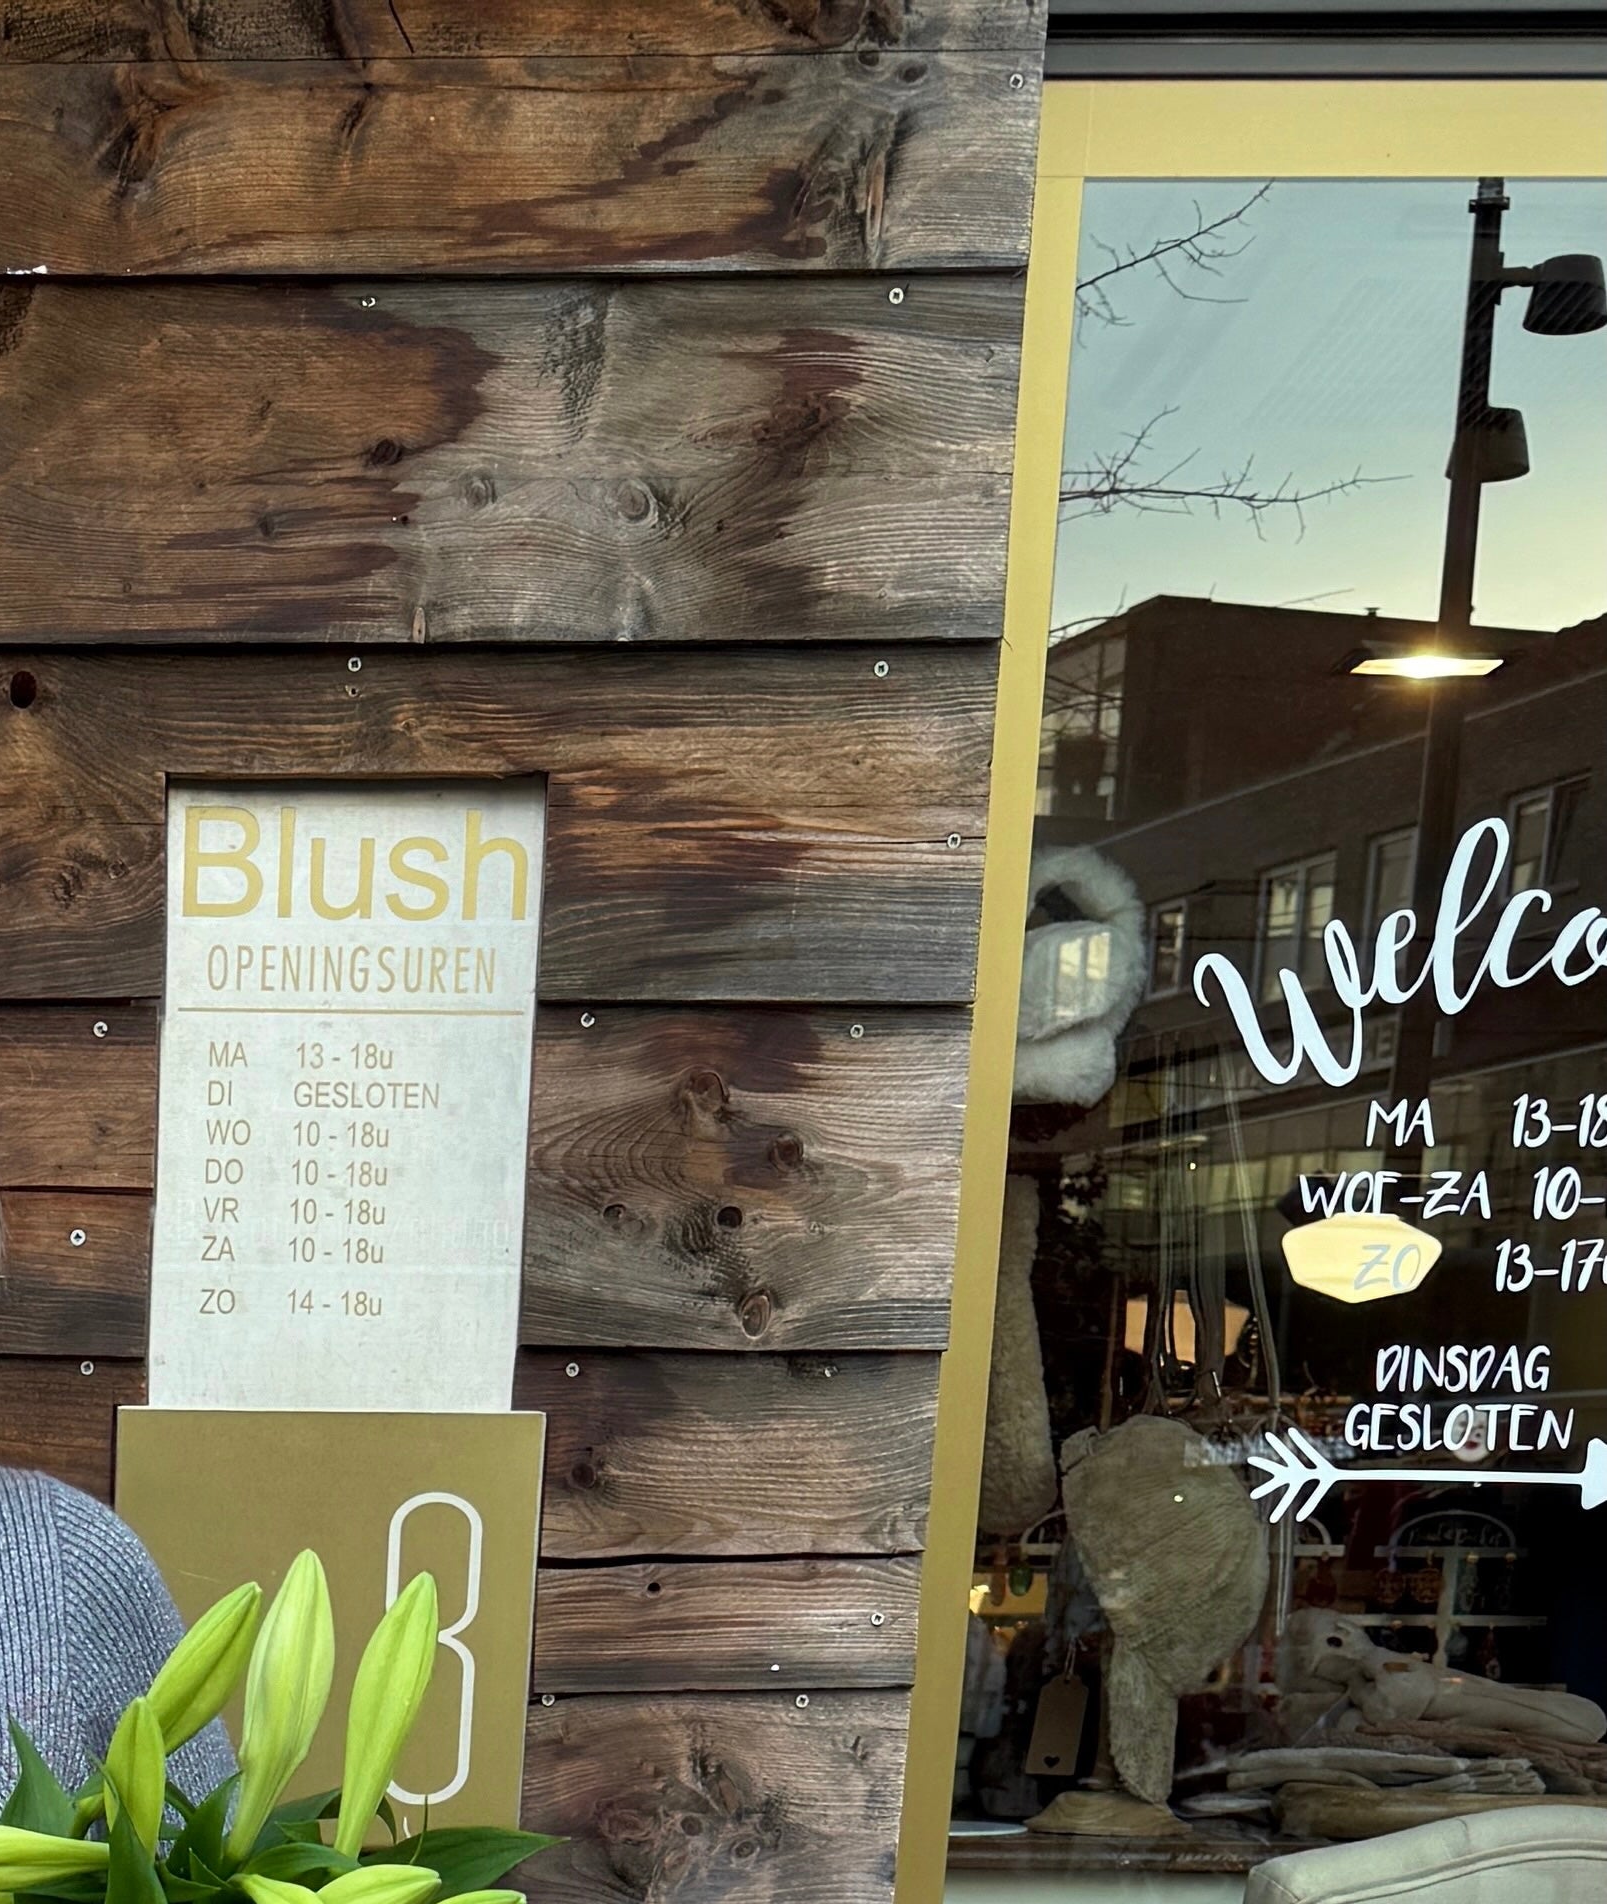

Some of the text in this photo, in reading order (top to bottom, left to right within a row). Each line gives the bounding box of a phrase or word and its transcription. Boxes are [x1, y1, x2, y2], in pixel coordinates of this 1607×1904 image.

[181, 806, 529, 921] Blush
[207, 944, 497, 995] OPENINGSUREN
[207, 1040, 249, 1068] MA
[296, 1042, 324, 1070] 13
[350, 1042, 394, 1070] 18u
[207, 1080, 440, 1109] DI GESLOTEN
[205, 1119, 251, 1146] WO
[292, 1120, 321, 1148] 10
[347, 1121, 390, 1149] 18u
[1365, 1097, 1435, 1147] MA
[204, 1158, 244, 1185] DO
[291, 1159, 319, 1186] 10
[345, 1160, 388, 1188] 18u
[202, 1196, 240, 1224] VR
[290, 1197, 317, 1225] 10
[343, 1198, 386, 1226] 18u
[1298, 1170, 1492, 1220] WOE-ZA
[200, 1234, 236, 1262] ZA
[288, 1236, 315, 1263] 10
[342, 1237, 384, 1265] 18u
[1353, 1238, 1607, 1292] ZO 13-17
[198, 1288, 236, 1315] ZO
[287, 1288, 315, 1315] 14
[340, 1289, 383, 1317] 18u
[1375, 1344, 1551, 1393] DINSDAG
[1344, 1402, 1575, 1451] GESLOTEN
